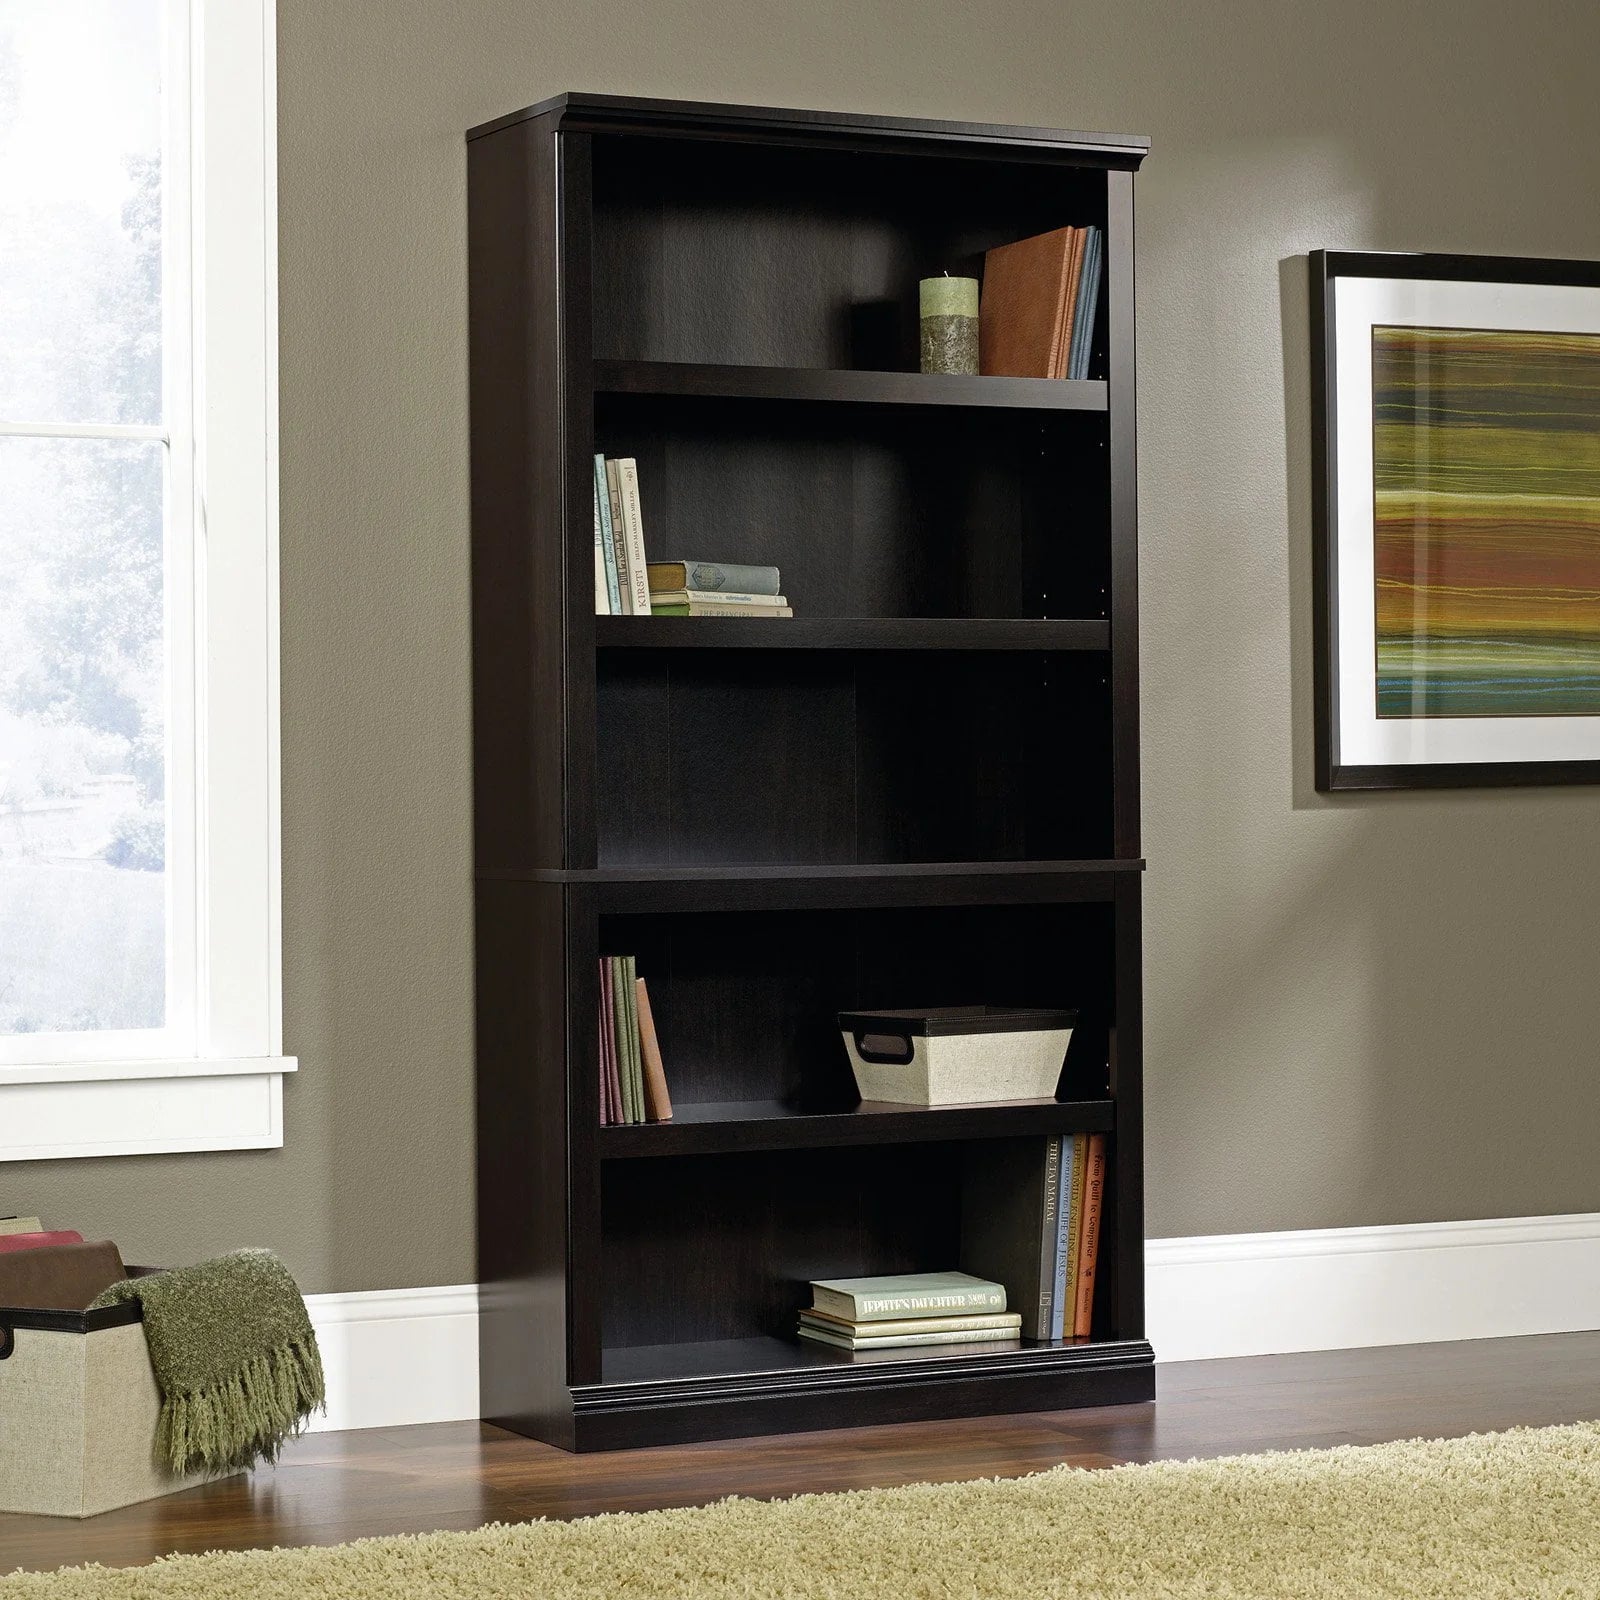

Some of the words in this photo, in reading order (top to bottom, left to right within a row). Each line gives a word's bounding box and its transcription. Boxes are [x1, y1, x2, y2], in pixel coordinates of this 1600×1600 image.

[635, 570, 647, 608] KIRSTI
[1050, 1141, 1058, 1164] THE
[1074, 1141, 1082, 1163] THE
[1047, 1165, 1056, 1183] TAJ
[1093, 1154, 1103, 1177] From
[1072, 1166, 1081, 1202] FAMILY
[1090, 1180, 1100, 1201] Quill
[1046, 1186, 1056, 1224] MAHAL
[1090, 1204, 1097, 1213] to
[1060, 1211, 1069, 1231] LIFE
[1067, 1206, 1078, 1257] KNITTING
[1059, 1234, 1067, 1246] OF
[1086, 1216, 1097, 1258] Computer
[1058, 1249, 1067, 1277] JESUS
[1065, 1260, 1074, 1290] BOOK
[911, 1295, 965, 1310] DAUGHTER
